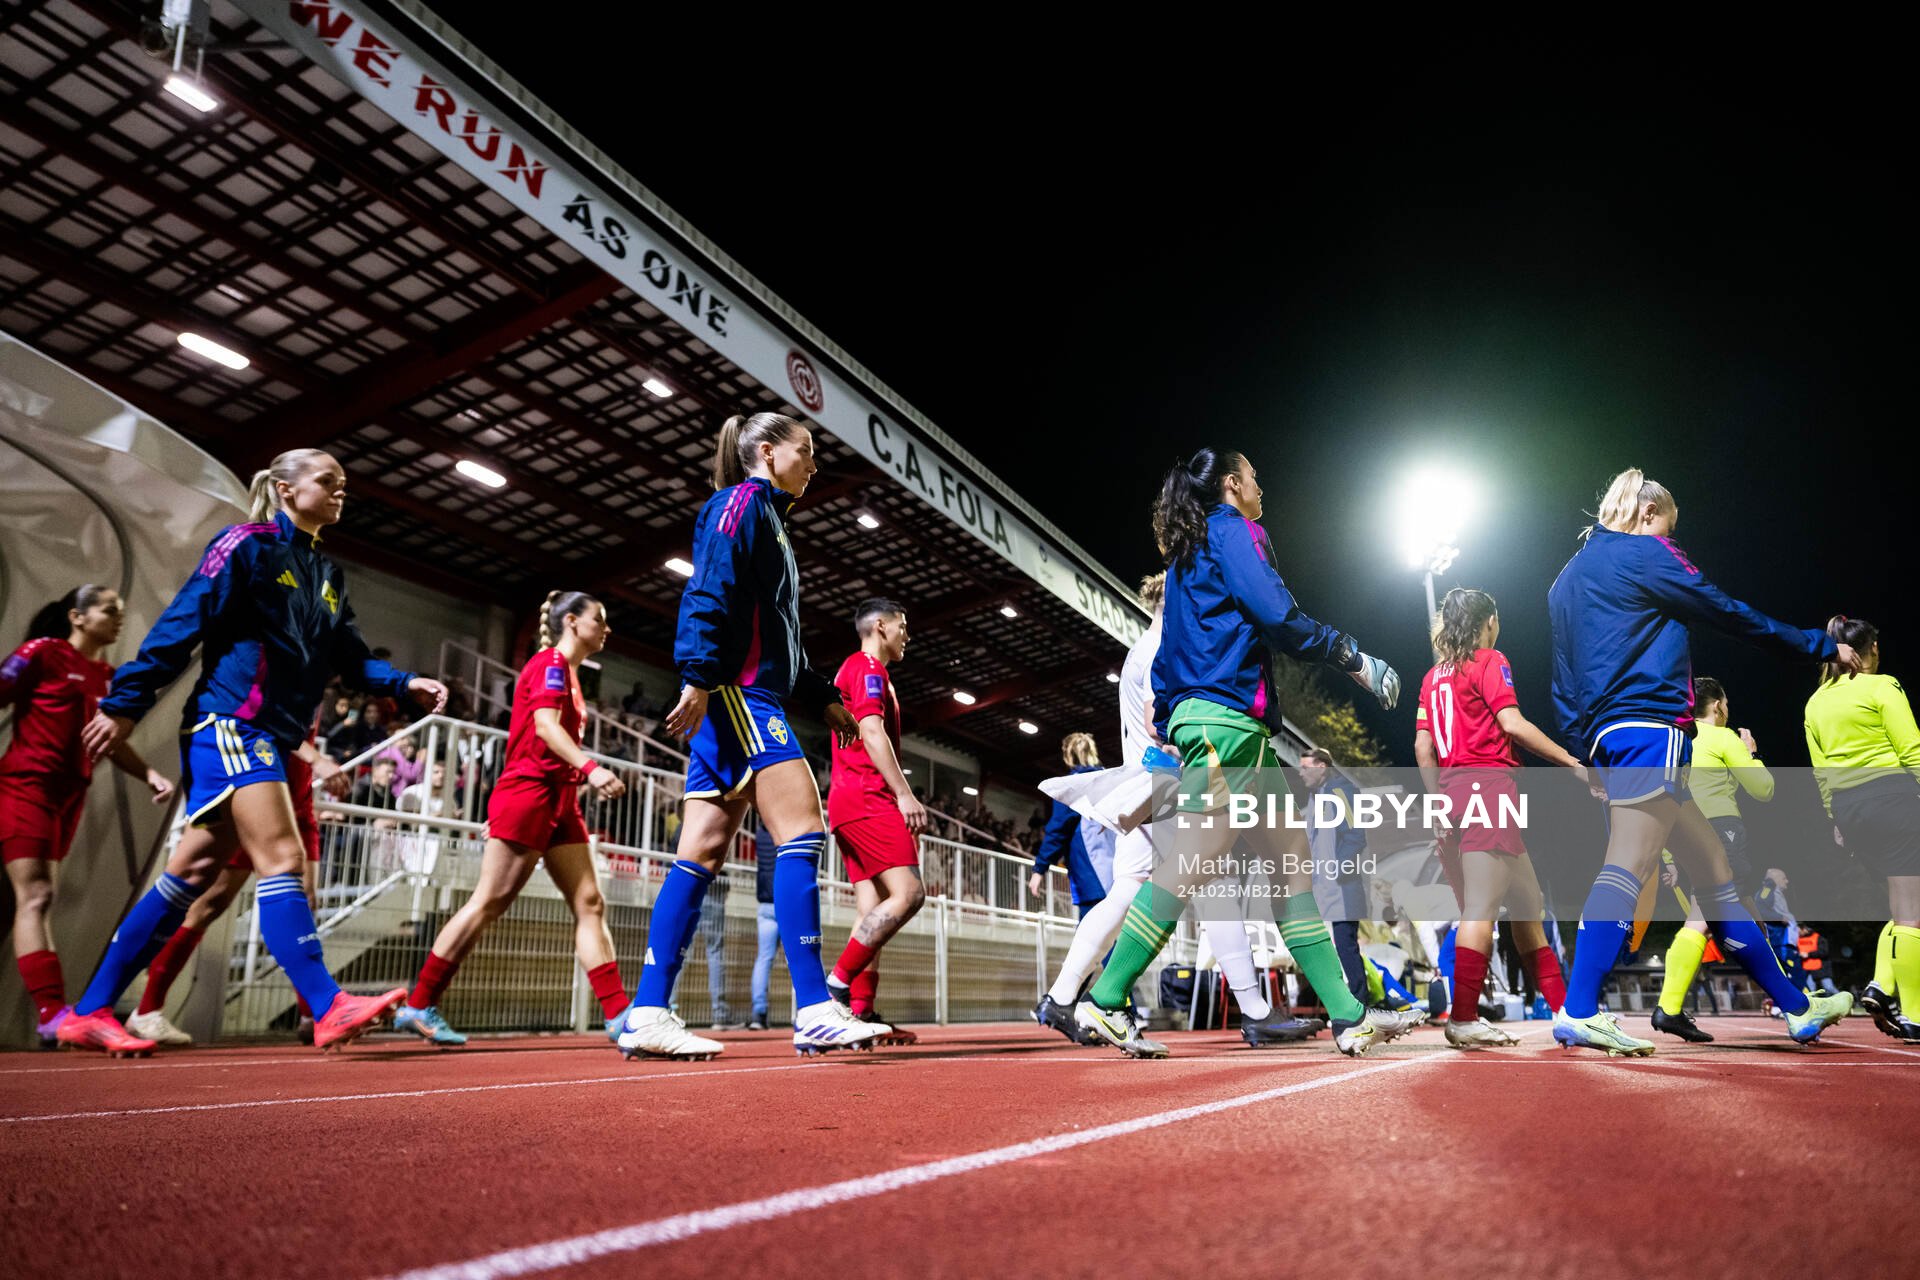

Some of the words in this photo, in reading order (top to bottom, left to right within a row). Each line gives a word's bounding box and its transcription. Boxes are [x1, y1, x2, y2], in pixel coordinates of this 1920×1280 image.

[289, 0, 402, 89] WE
[411, 74, 551, 200] RUN
[561, 193, 630, 259] AS
[639, 249, 732, 318] ONE
